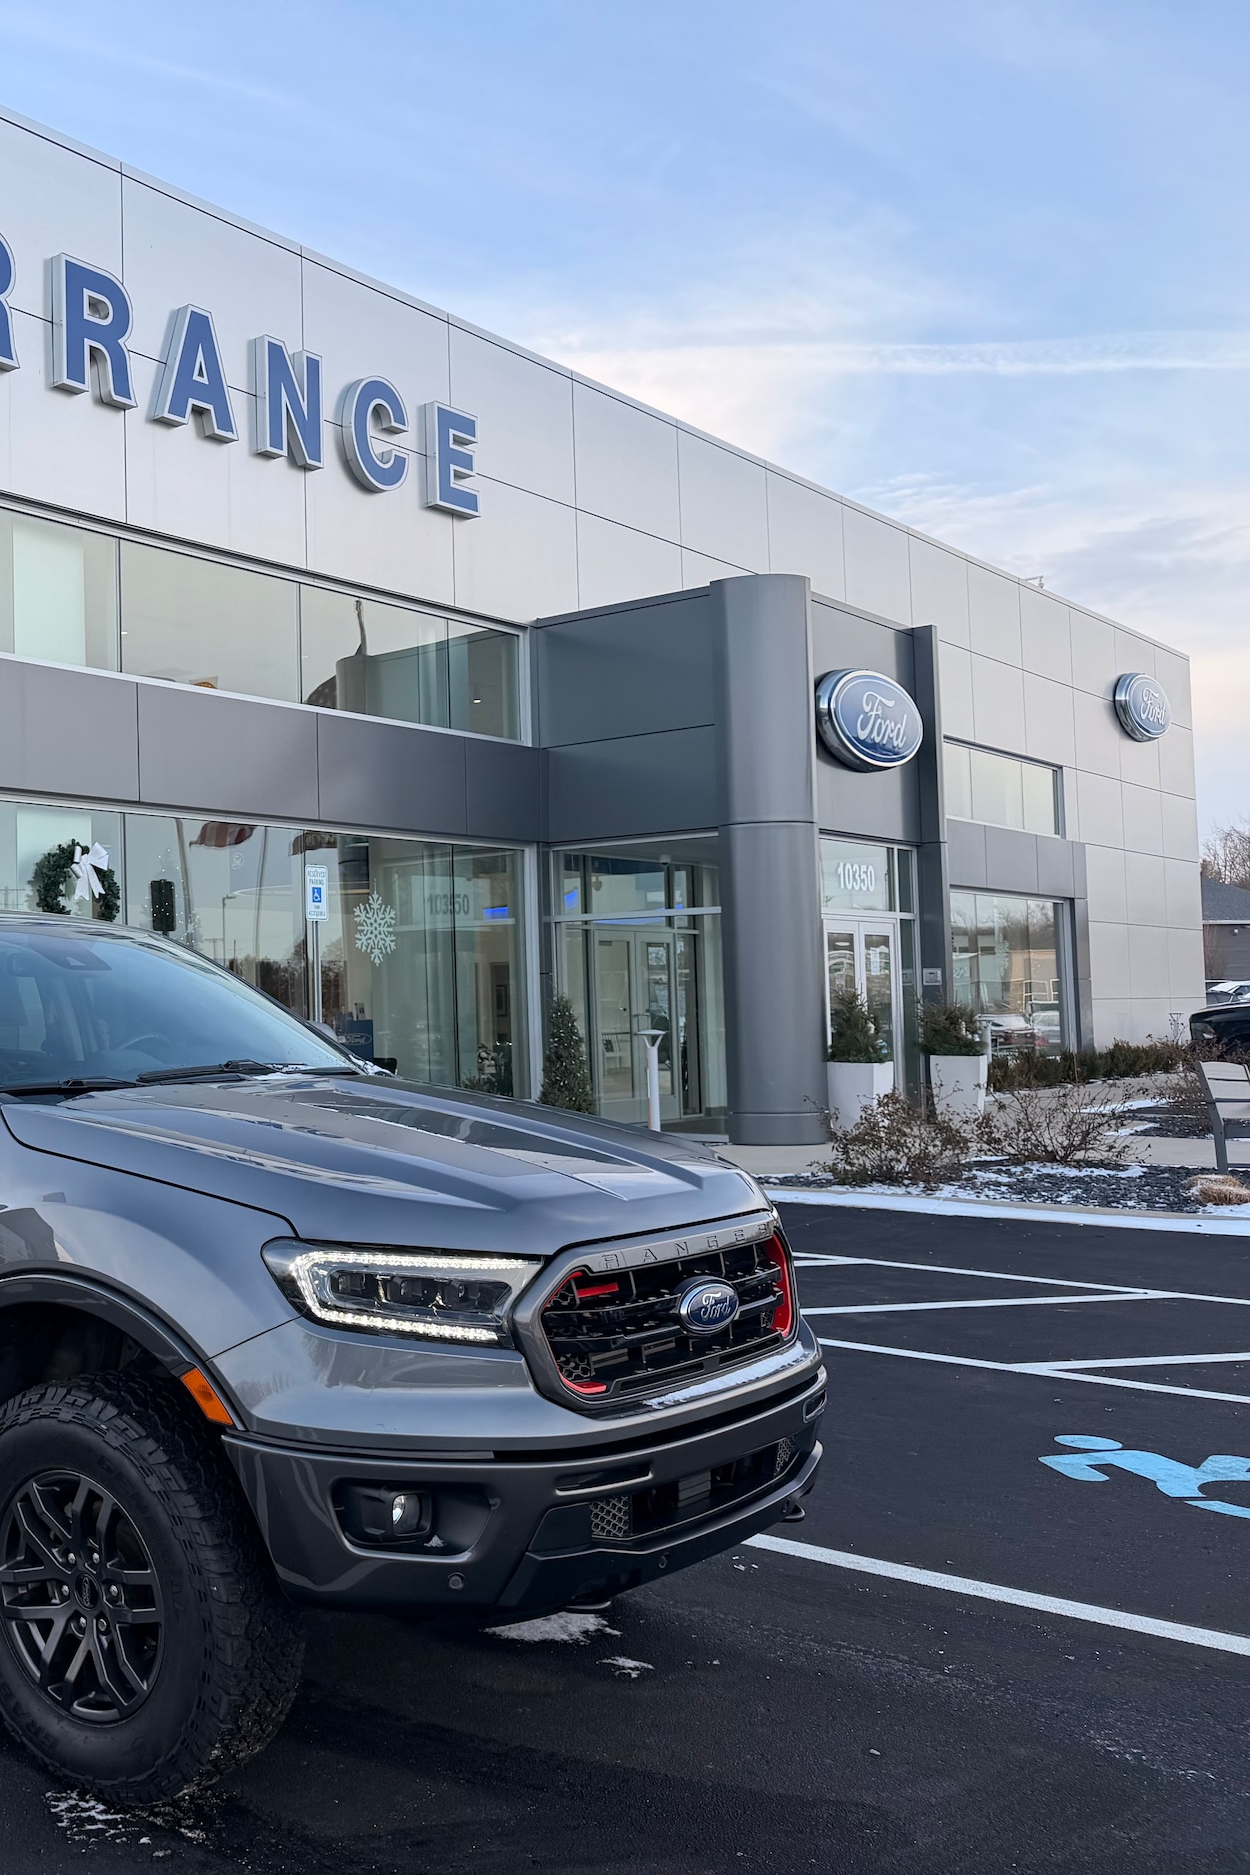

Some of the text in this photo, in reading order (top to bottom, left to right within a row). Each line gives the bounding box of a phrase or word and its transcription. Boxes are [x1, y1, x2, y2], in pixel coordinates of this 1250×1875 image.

[856, 691, 907, 749] Ford
[1140, 687, 1166, 725] Ford
[837, 862, 876, 892] 10350
[601, 1223, 767, 1270] RANGER
[700, 1291, 731, 1320] Ford
